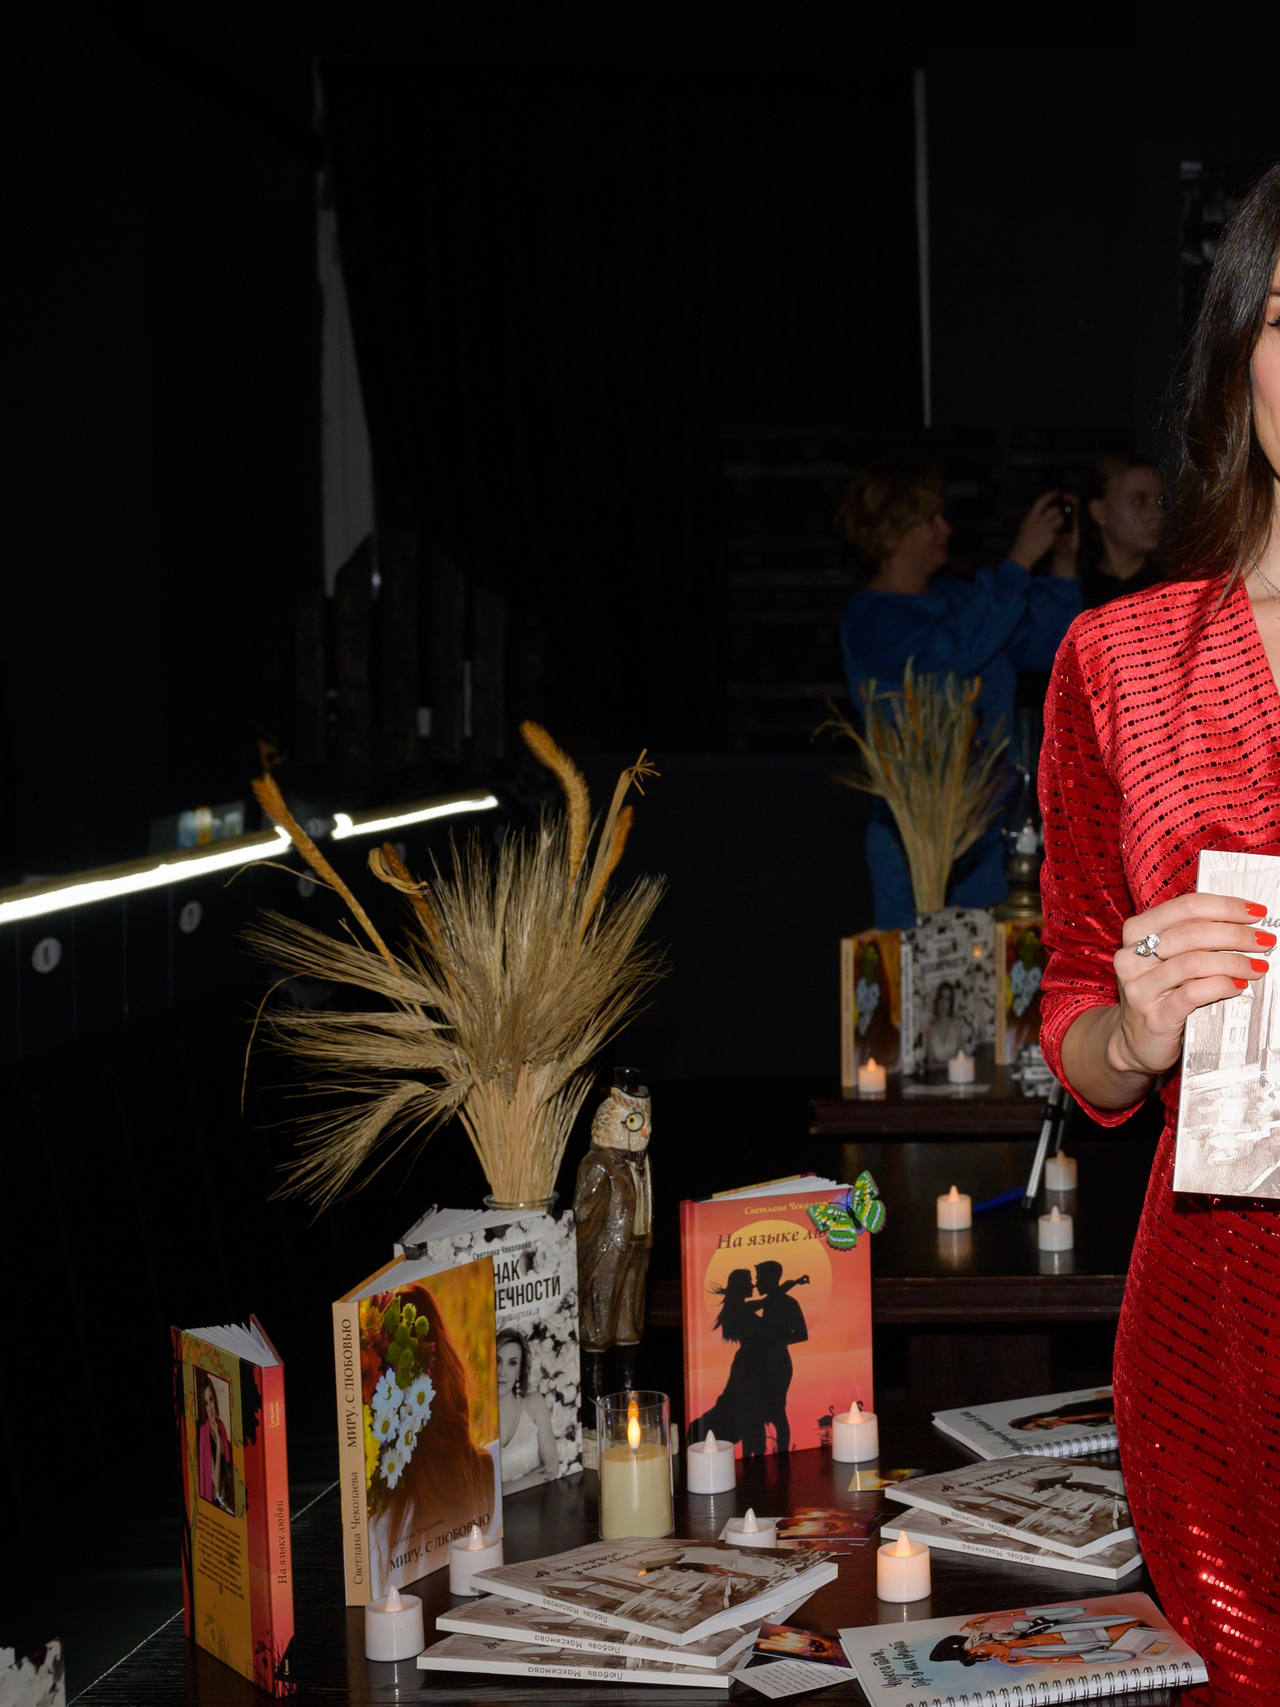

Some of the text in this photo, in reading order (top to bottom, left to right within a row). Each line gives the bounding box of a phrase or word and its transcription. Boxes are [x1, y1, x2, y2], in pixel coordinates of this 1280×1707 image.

[744, 1204, 787, 1215] Светлана
[501, 1241, 532, 1254] Чеколаева
[717, 1228, 828, 1249] На языке лю
[493, 1259, 520, 1285] НАК
[494, 1275, 561, 1311] ЕЧНОСТИ
[341, 1318, 359, 1448] МИРУ. С ЛЮБОВЬЮ
[350, 1471, 363, 1586] Светлана Чеколаева
[274, 1500, 288, 1585] На языке любви
[390, 1513, 490, 1571] МИРУ. С ЛЮБОВЬЮ
[962, 1543, 1035, 1563] Любовь Максимова
[542, 1598, 608, 1624] Любовь Максимова
[534, 1634, 621, 1654] Любовь Максимова
[527, 1666, 624, 1681] Любовь Максимова
